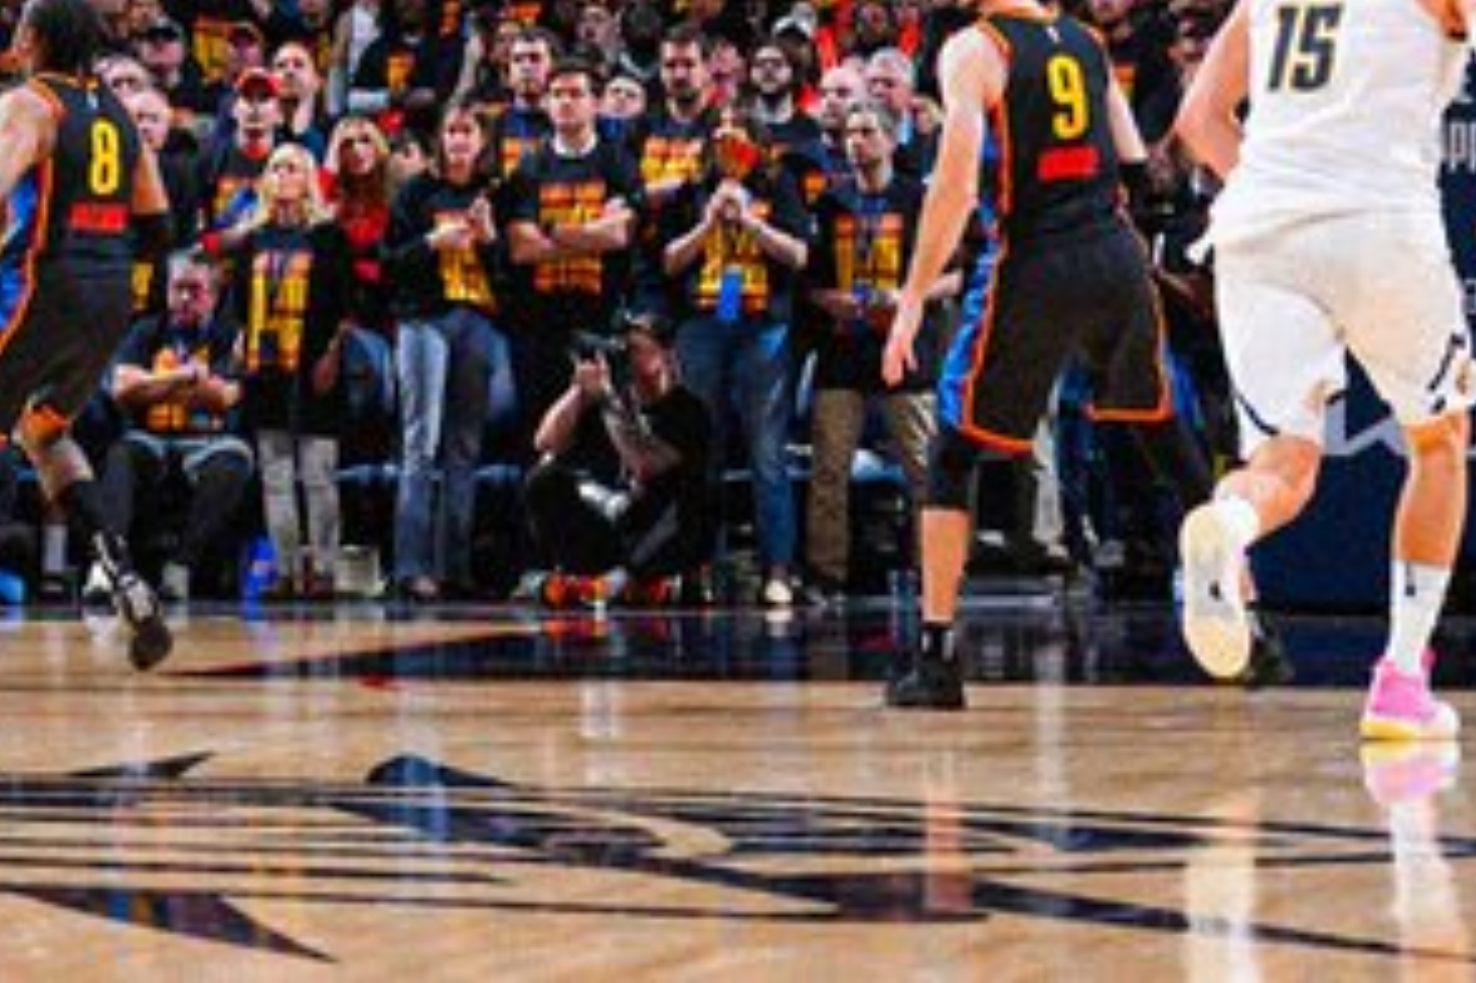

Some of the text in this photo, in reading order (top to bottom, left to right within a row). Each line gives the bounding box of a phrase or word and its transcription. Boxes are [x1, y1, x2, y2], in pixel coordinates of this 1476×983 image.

[1267, 2, 1344, 92] 15
[1046, 54, 1088, 139] 9
[90, 117, 120, 195] 8
